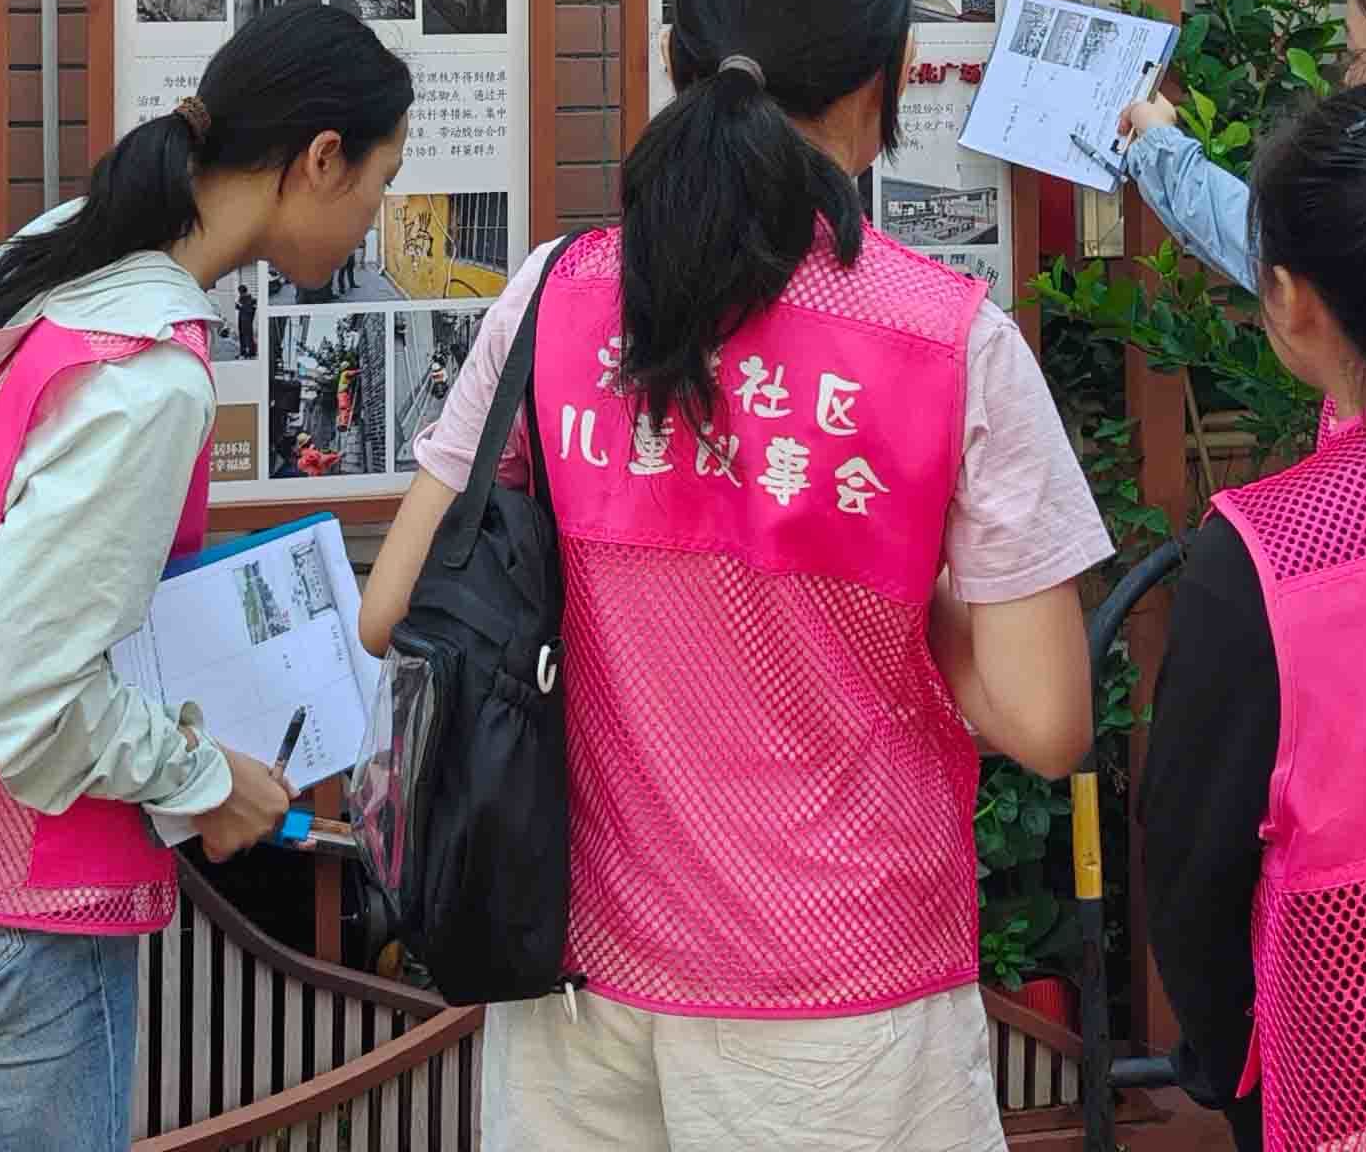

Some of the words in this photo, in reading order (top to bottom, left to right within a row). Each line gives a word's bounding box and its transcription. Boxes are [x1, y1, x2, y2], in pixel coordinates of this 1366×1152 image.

[561, 404, 890, 516] 儿童议事会
